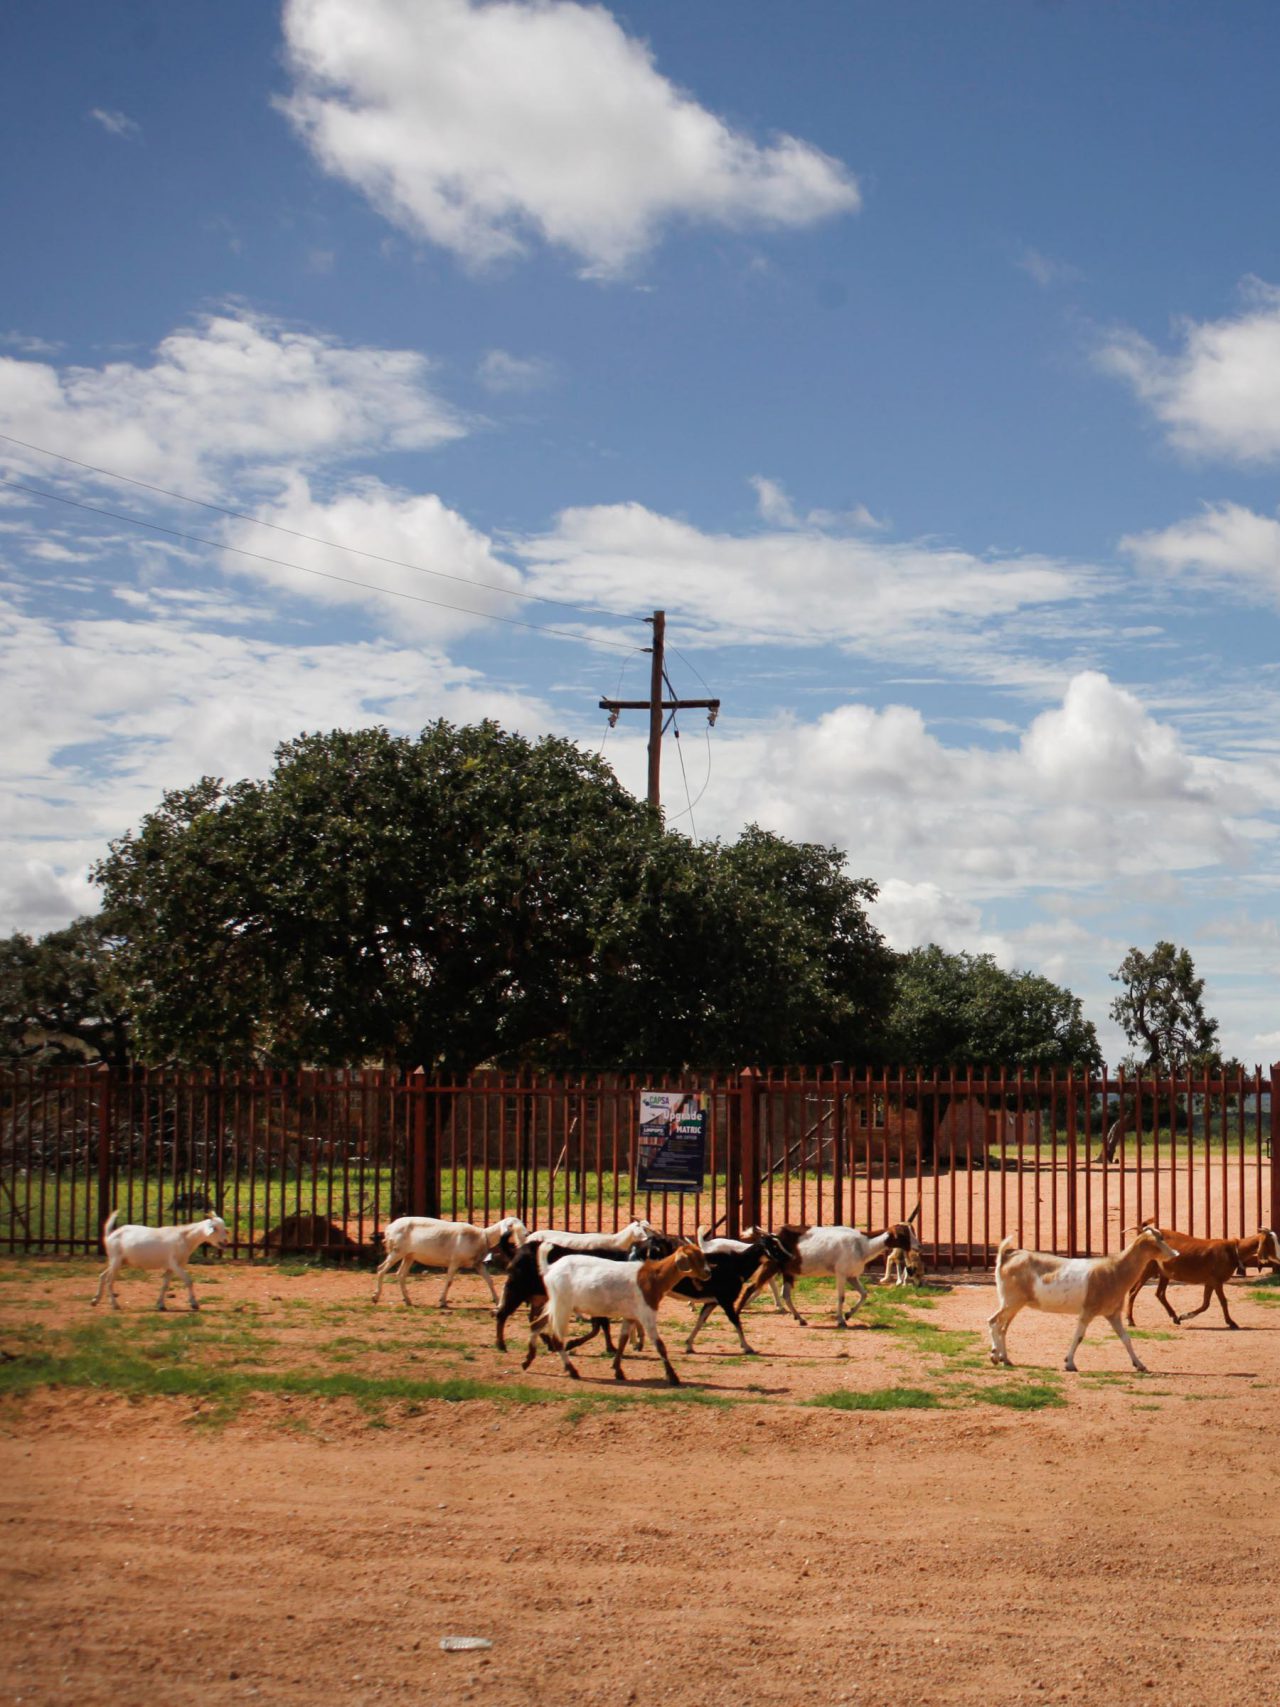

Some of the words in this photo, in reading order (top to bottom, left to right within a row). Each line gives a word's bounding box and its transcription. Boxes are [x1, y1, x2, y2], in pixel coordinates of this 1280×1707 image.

[650, 1096, 669, 1104] CAPSA
[663, 1110, 702, 1122] Upgrade
[676, 1126, 702, 1134] MATRIC
